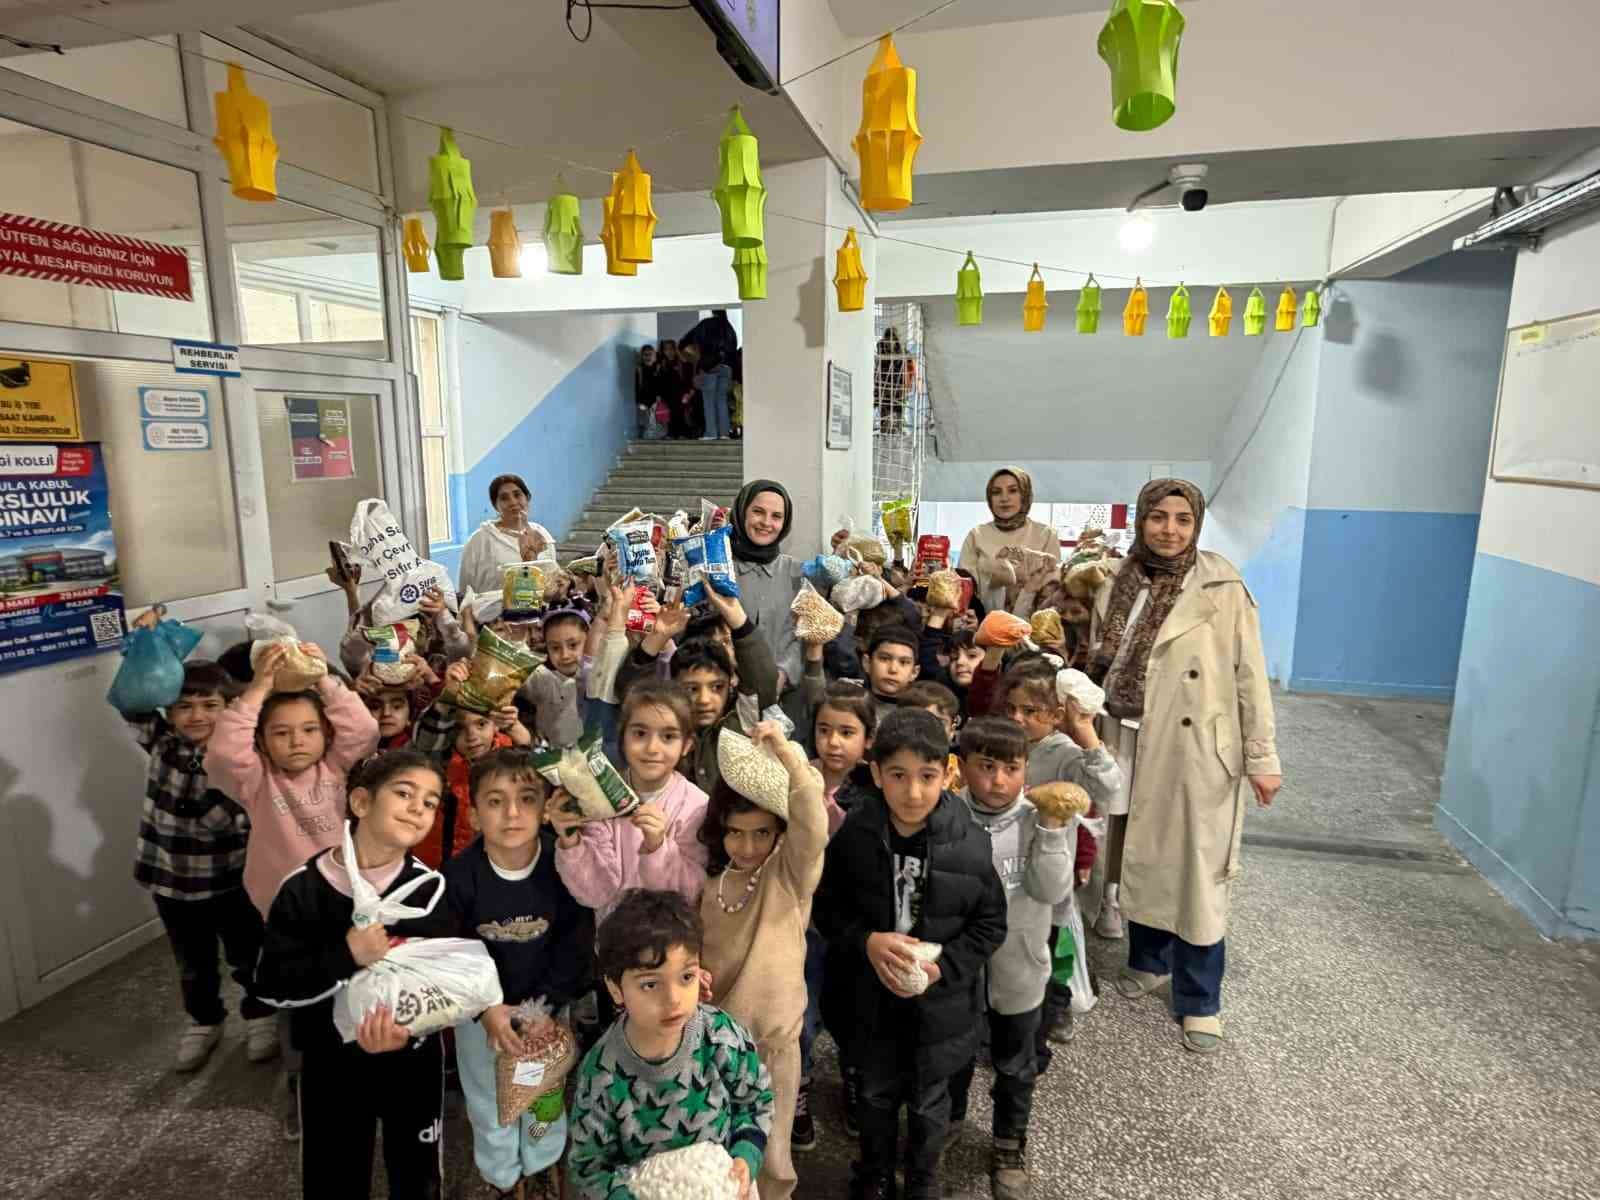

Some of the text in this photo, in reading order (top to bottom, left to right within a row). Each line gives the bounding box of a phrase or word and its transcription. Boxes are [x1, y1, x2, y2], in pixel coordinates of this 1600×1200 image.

[52, 238, 128, 262] SAĞLIĞINIZ
[130, 248, 156, 267] İÇİN
[33, 254, 114, 276] MESAFENİZİ
[115, 268, 174, 287] KORUYUN
[15, 454, 55, 467] KOLEJİ
[28, 479, 73, 490] KABUL
[73, 587, 99, 599] MART
[5, 597, 35, 609] MART
